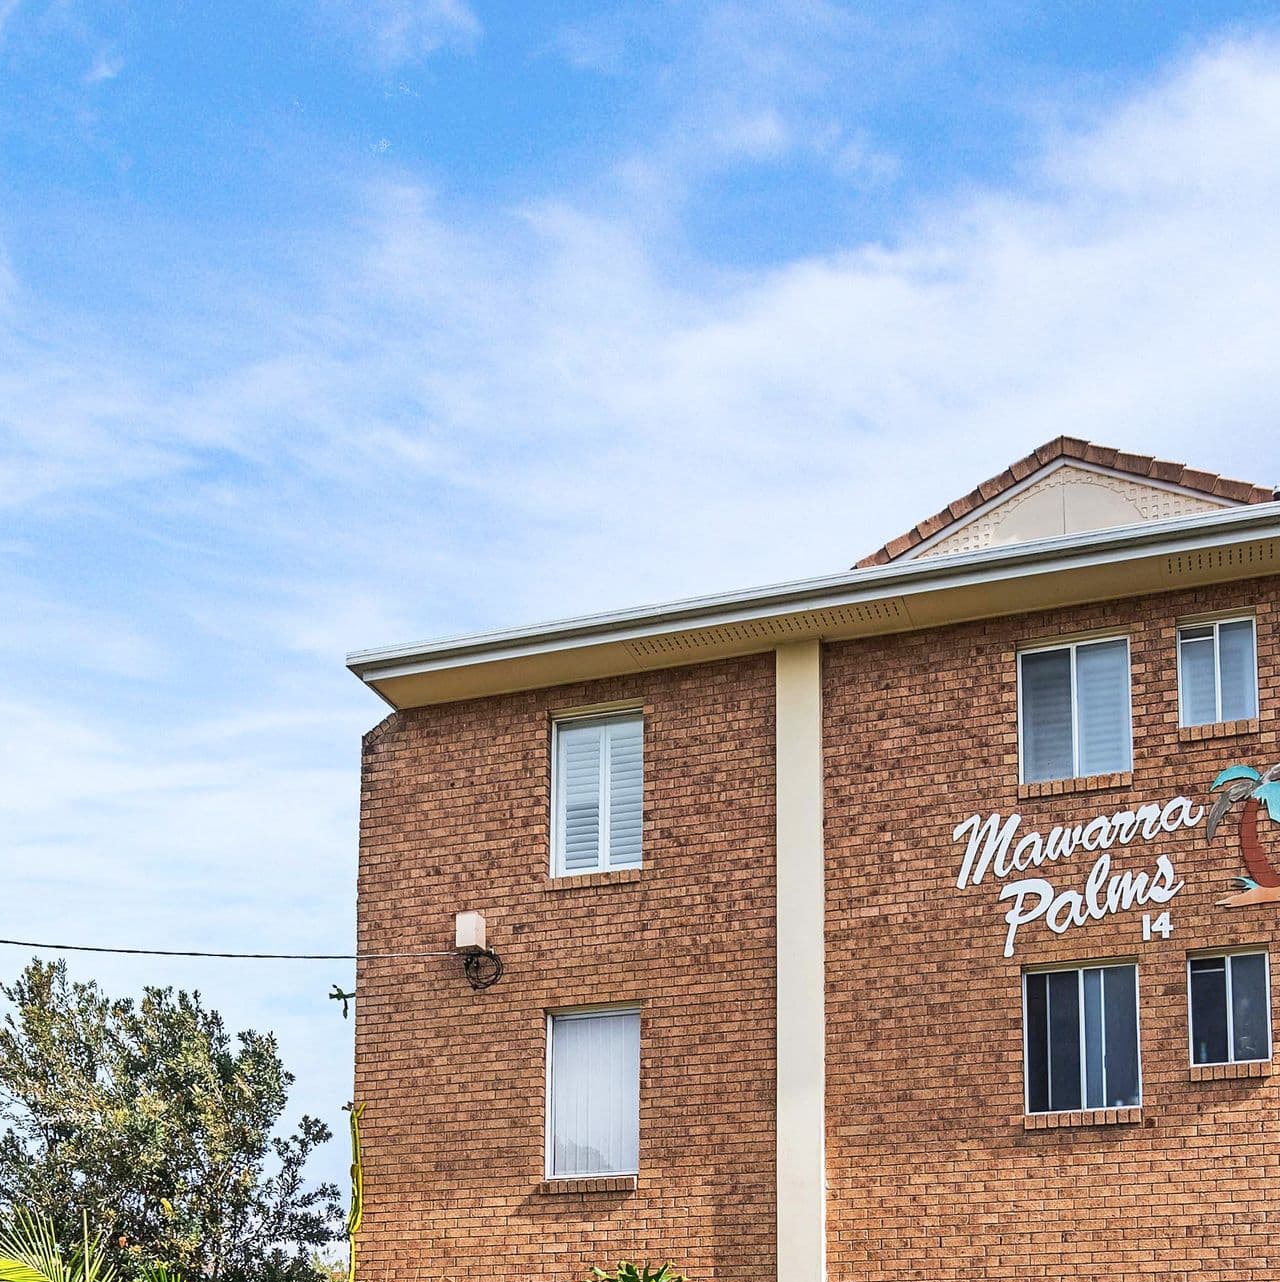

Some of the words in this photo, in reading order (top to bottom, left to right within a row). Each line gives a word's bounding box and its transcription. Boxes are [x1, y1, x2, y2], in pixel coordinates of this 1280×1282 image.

[952, 795, 1204, 890] Mawarra
[998, 853, 1185, 958] Palms
[1142, 911, 1174, 941] 14
